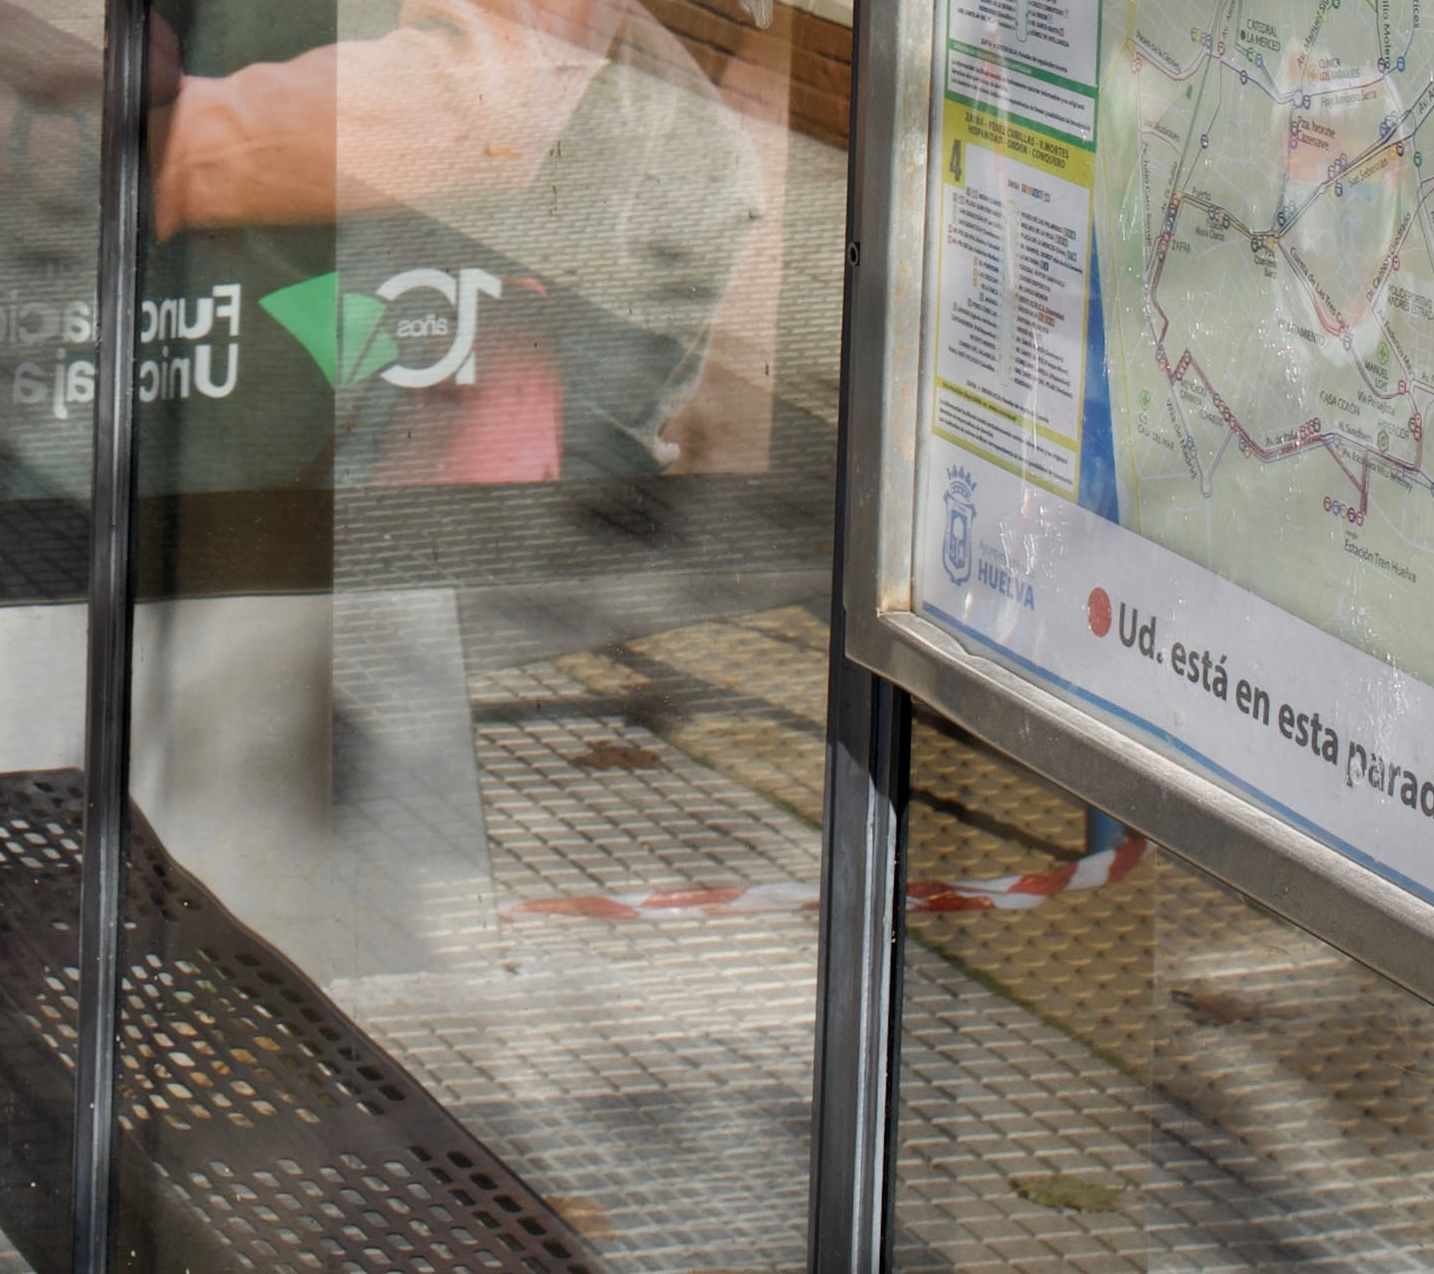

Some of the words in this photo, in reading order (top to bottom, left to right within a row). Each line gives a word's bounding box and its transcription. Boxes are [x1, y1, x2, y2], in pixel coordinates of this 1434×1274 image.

[949, 139, 962, 183] 4
[977, 558, 1035, 612] HUELVA
[1118, 600, 1163, 664] Ud.
[1170, 638, 1227, 702] está
[1235, 675, 1270, 725] en
[1279, 703, 1338, 765] esta
